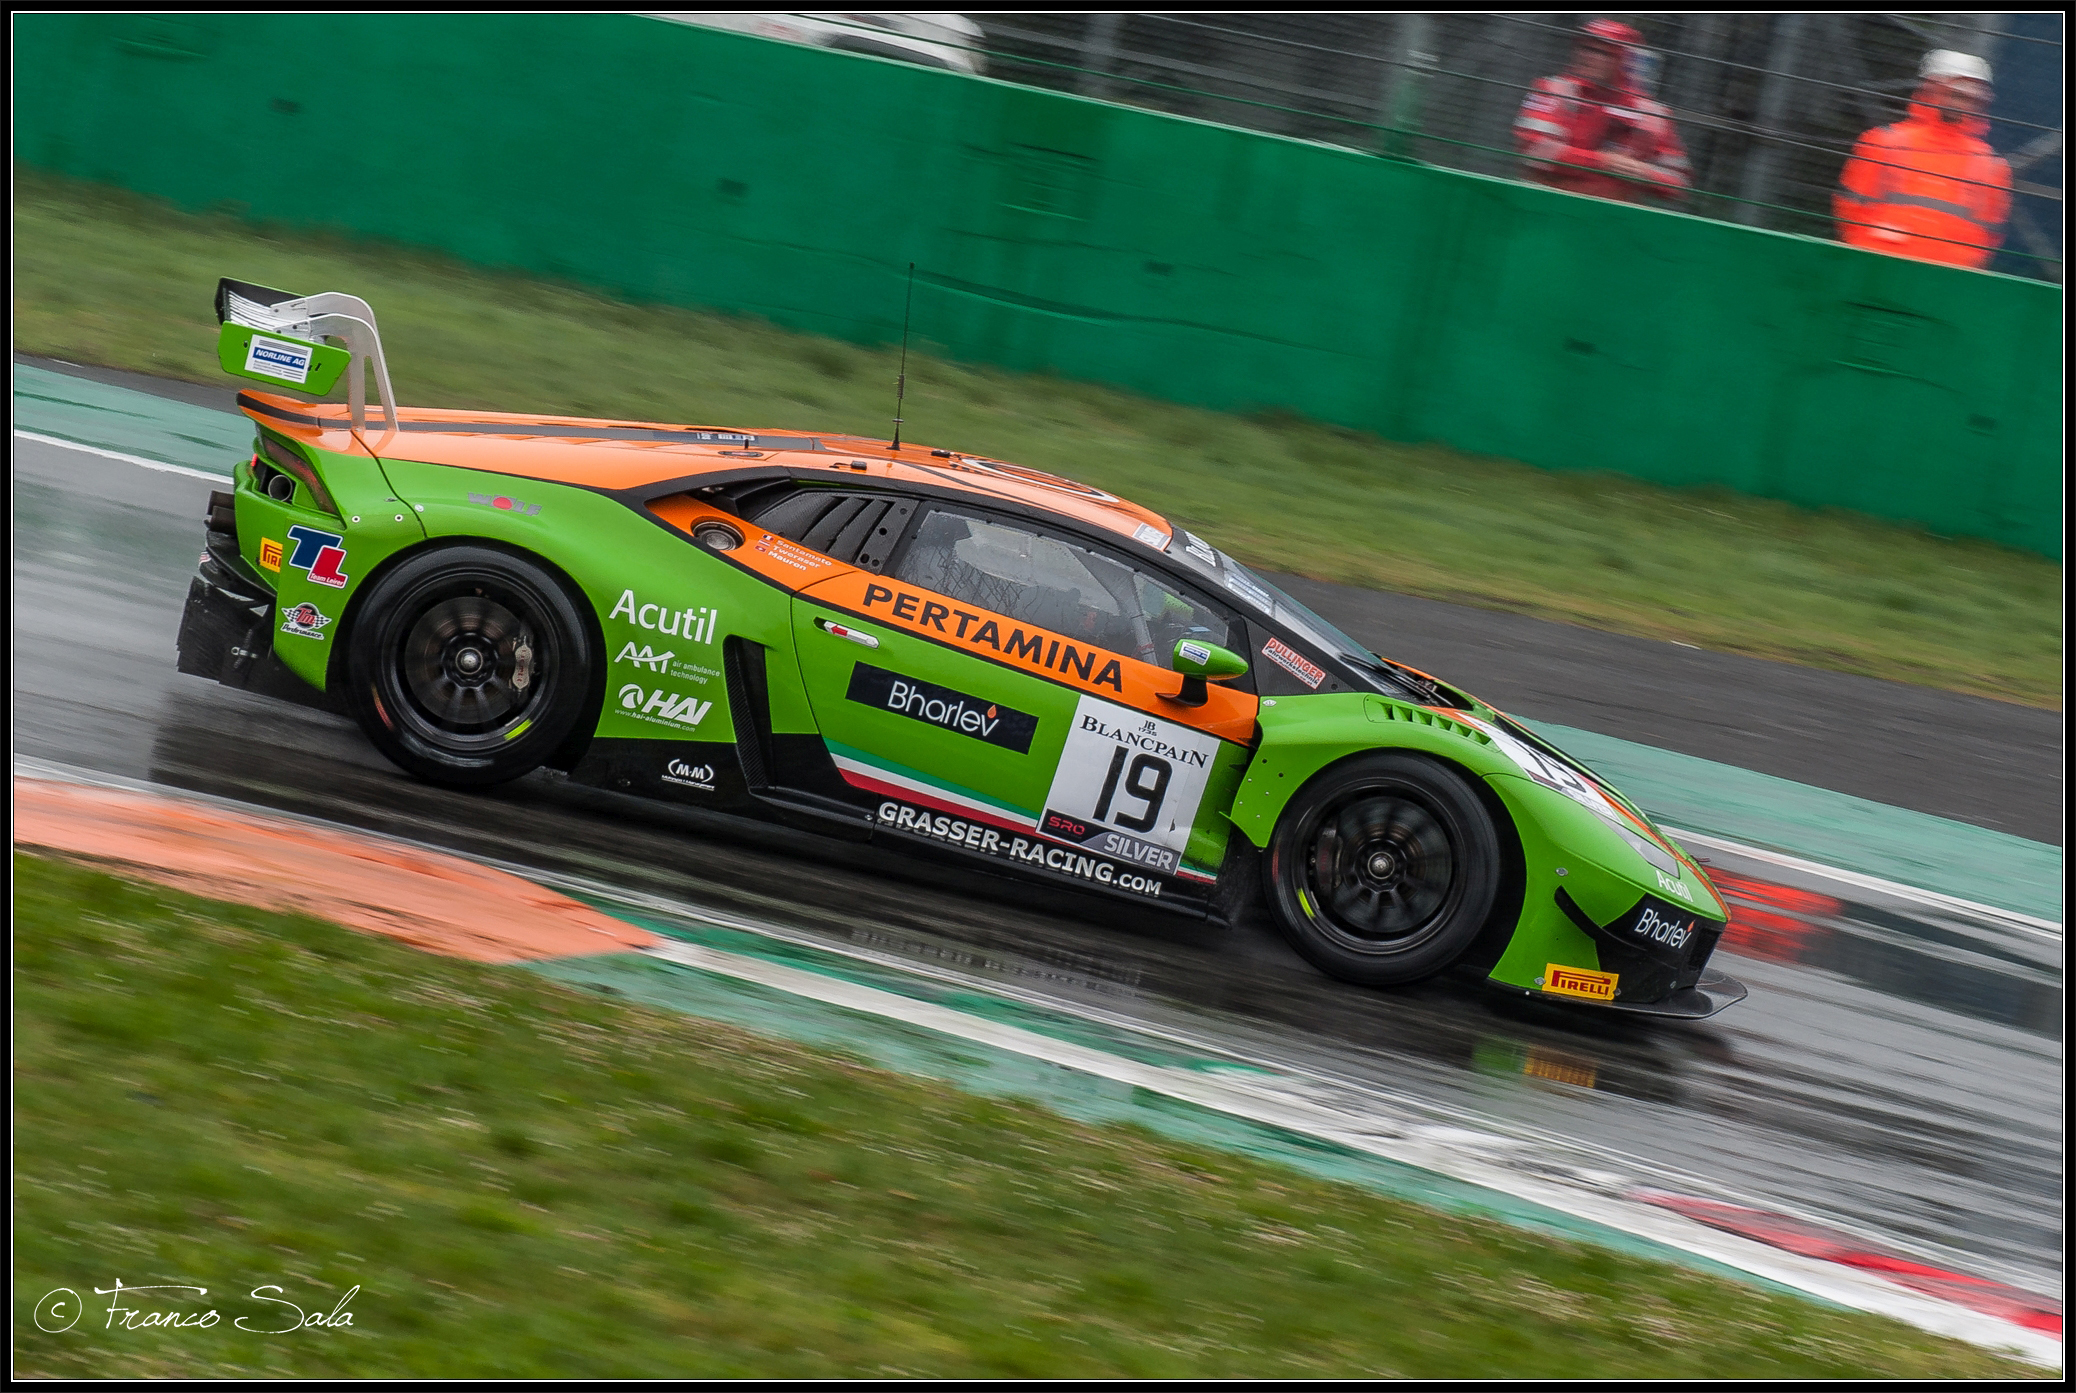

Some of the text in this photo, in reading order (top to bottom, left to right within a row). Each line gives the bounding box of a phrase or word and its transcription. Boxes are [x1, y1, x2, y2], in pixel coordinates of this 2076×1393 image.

[255, 349, 306, 366] NORLINE AG
[467, 491, 543, 517] WOLF
[767, 550, 807, 571] Mauron
[310, 572, 327, 582] Team
[608, 589, 718, 645] Acutil
[863, 583, 1124, 693] PERTAMINA
[683, 662, 721, 677] ambulance
[1267, 638, 1324, 680] DULLINGER
[670, 669, 708, 685] technology
[614, 708, 696, 733] www.hai-aluminium.com
[887, 680, 1000, 738] Bharlev
[1078, 714, 1209, 769] BLANCPAIN
[1138, 726, 1157, 737] 1735
[1092, 744, 1173, 834] 19
[1047, 815, 1086, 836] SRO
[878, 801, 1162, 895] GRASSER-RACING.COM
[1103, 833, 1174, 871] SILVER
[1654, 869, 1695, 903] Acutil
[1634, 907, 1694, 950] Bharlev
[1550, 969, 1611, 997] PIRELLI
